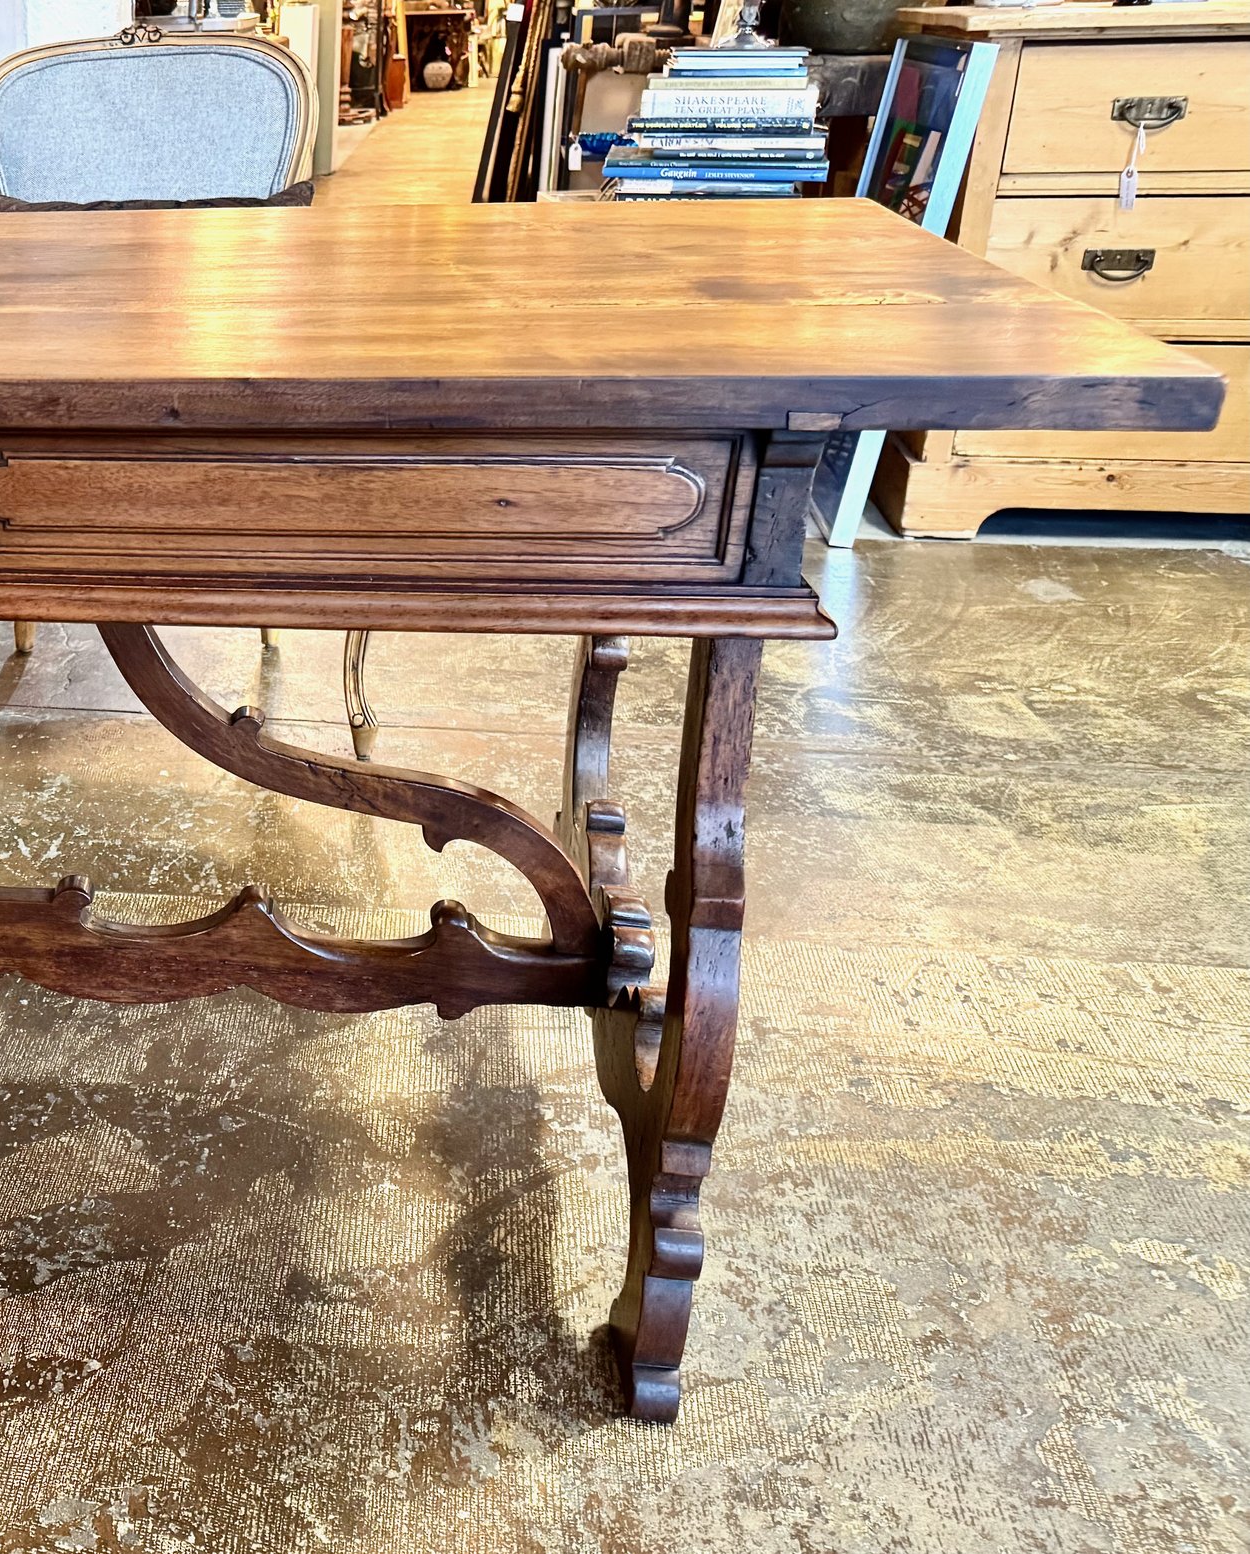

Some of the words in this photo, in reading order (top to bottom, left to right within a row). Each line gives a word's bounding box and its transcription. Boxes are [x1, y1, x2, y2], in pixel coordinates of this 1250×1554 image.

[674, 96, 767, 105] SHAKESPEARE
[674, 106, 694, 114] TEN
[698, 106, 735, 114] GREAT
[737, 106, 767, 115] PLAYS
[660, 168, 697, 179] Gauguin
